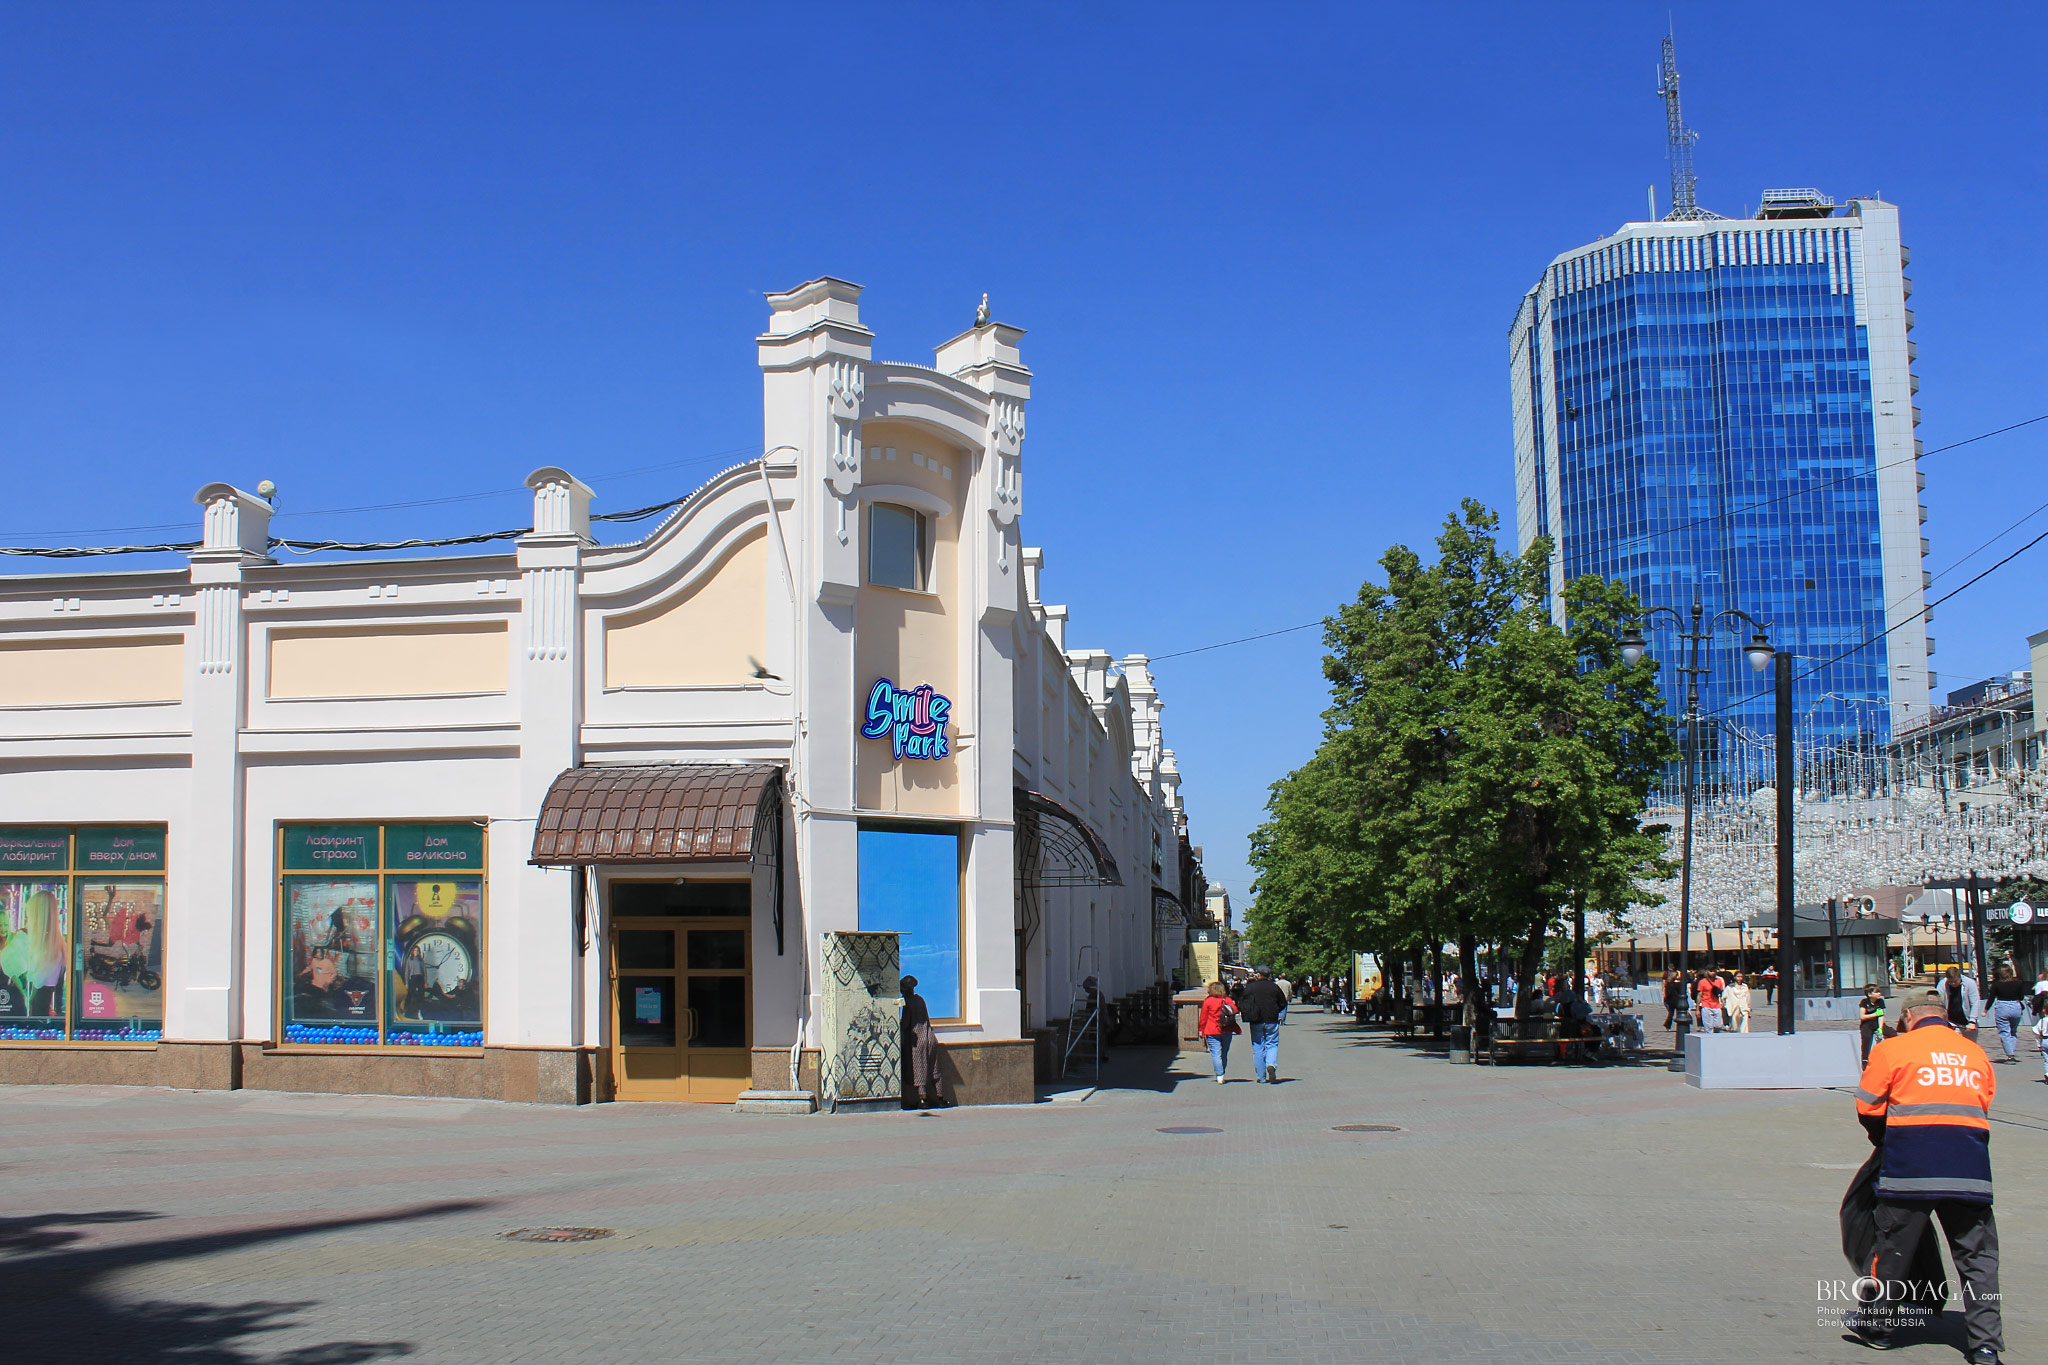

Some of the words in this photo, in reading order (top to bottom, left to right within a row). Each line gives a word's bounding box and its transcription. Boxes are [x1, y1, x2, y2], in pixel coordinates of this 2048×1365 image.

[864, 682, 950, 735] Smile
[895, 722, 947, 757] Park
[113, 837, 134, 847] Дом
[306, 835, 364, 848] Лабиринт
[425, 836, 448, 847] Дом
[89, 852, 124, 863] вверх
[128, 852, 157, 861] дном
[312, 850, 358, 862] страха
[406, 851, 467, 861] великана
[1930, 1051, 1968, 1067] МБУ
[1916, 1066, 1981, 1090] ЭВИС
